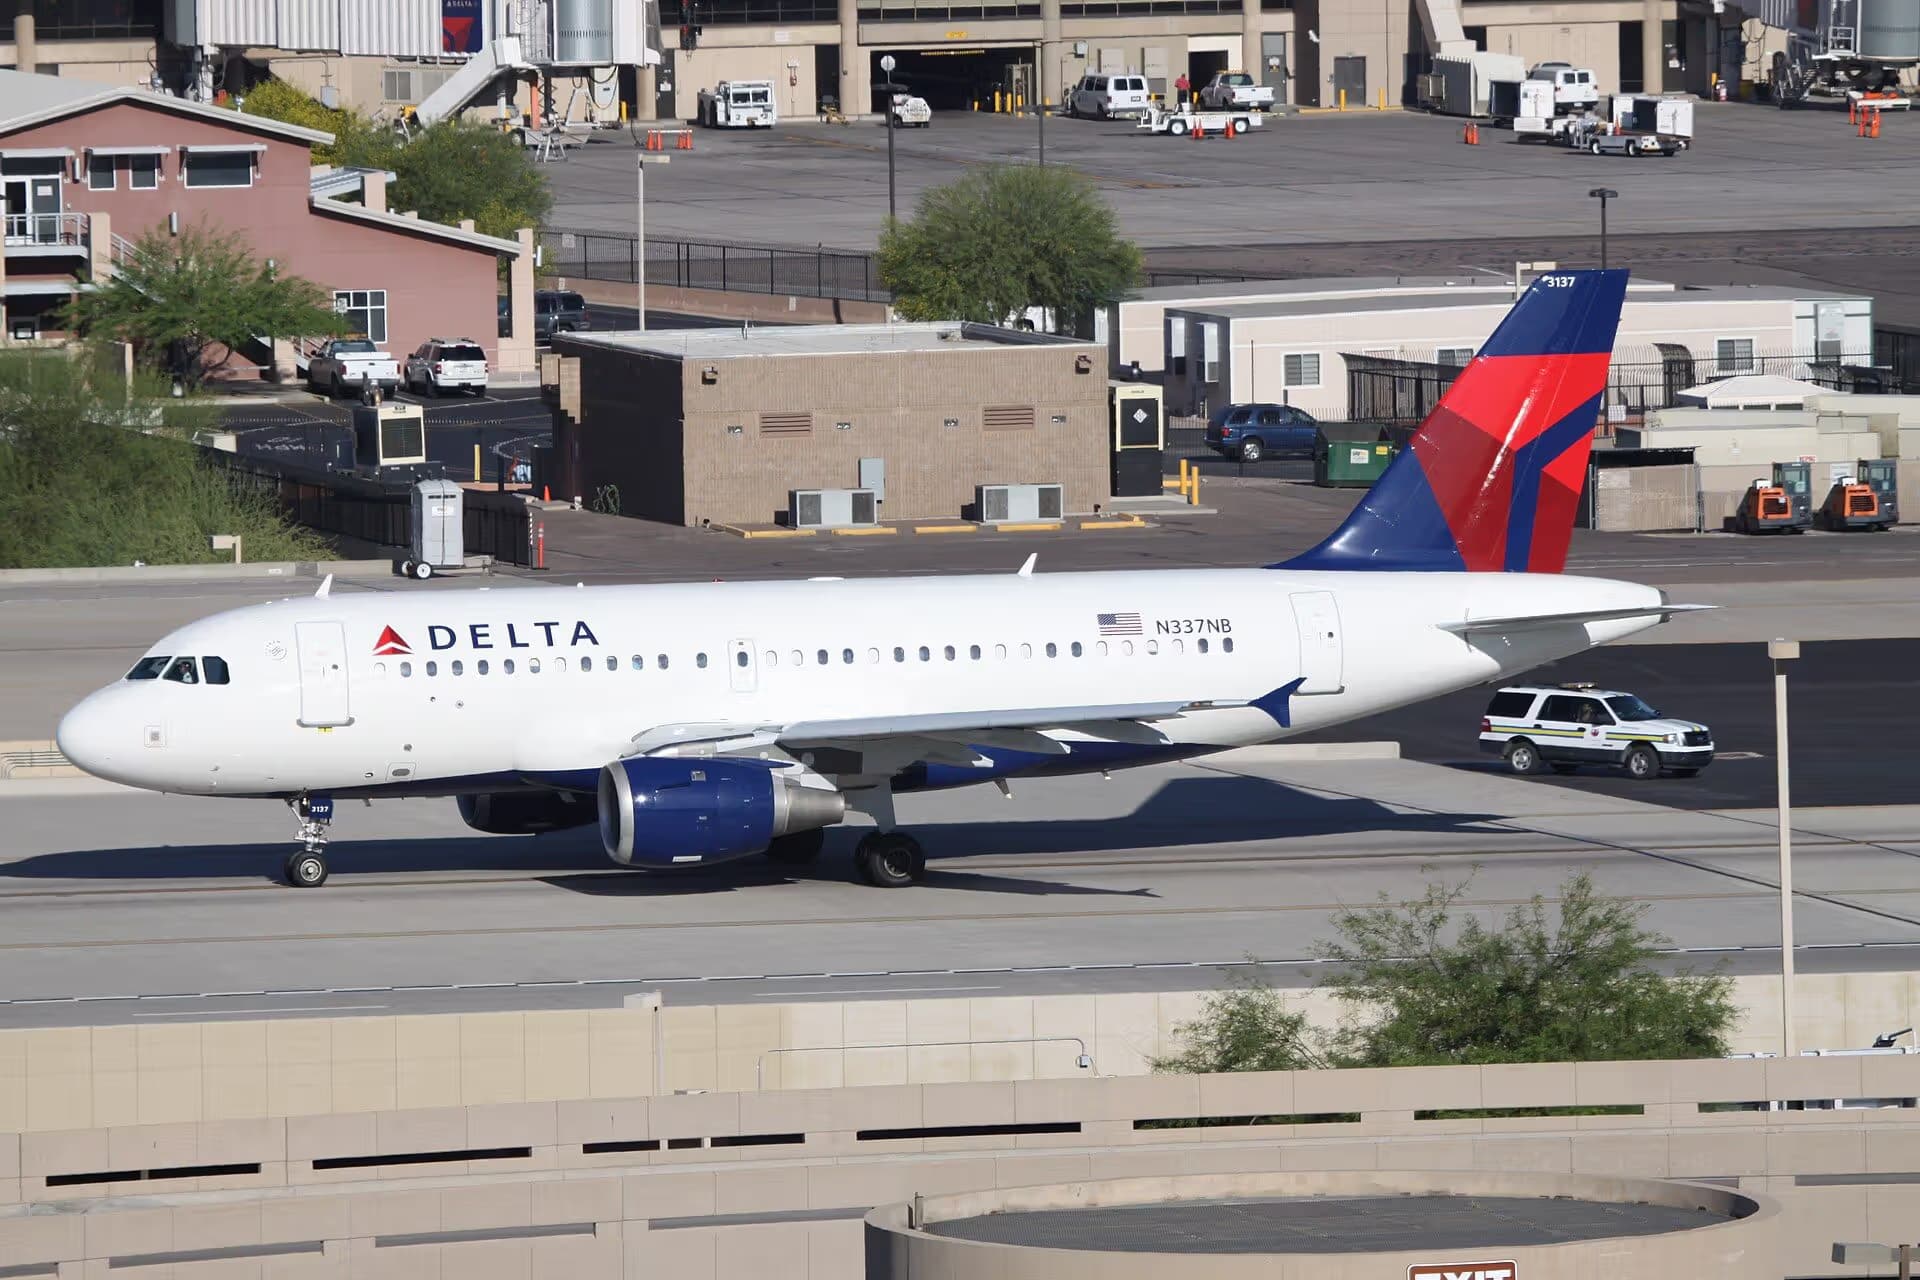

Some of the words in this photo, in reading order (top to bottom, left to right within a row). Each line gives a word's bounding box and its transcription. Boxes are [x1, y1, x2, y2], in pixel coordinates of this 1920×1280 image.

[1547, 276, 1576, 288] 3137
[1156, 618, 1232, 634] N337NB
[427, 620, 600, 650] DELTA
